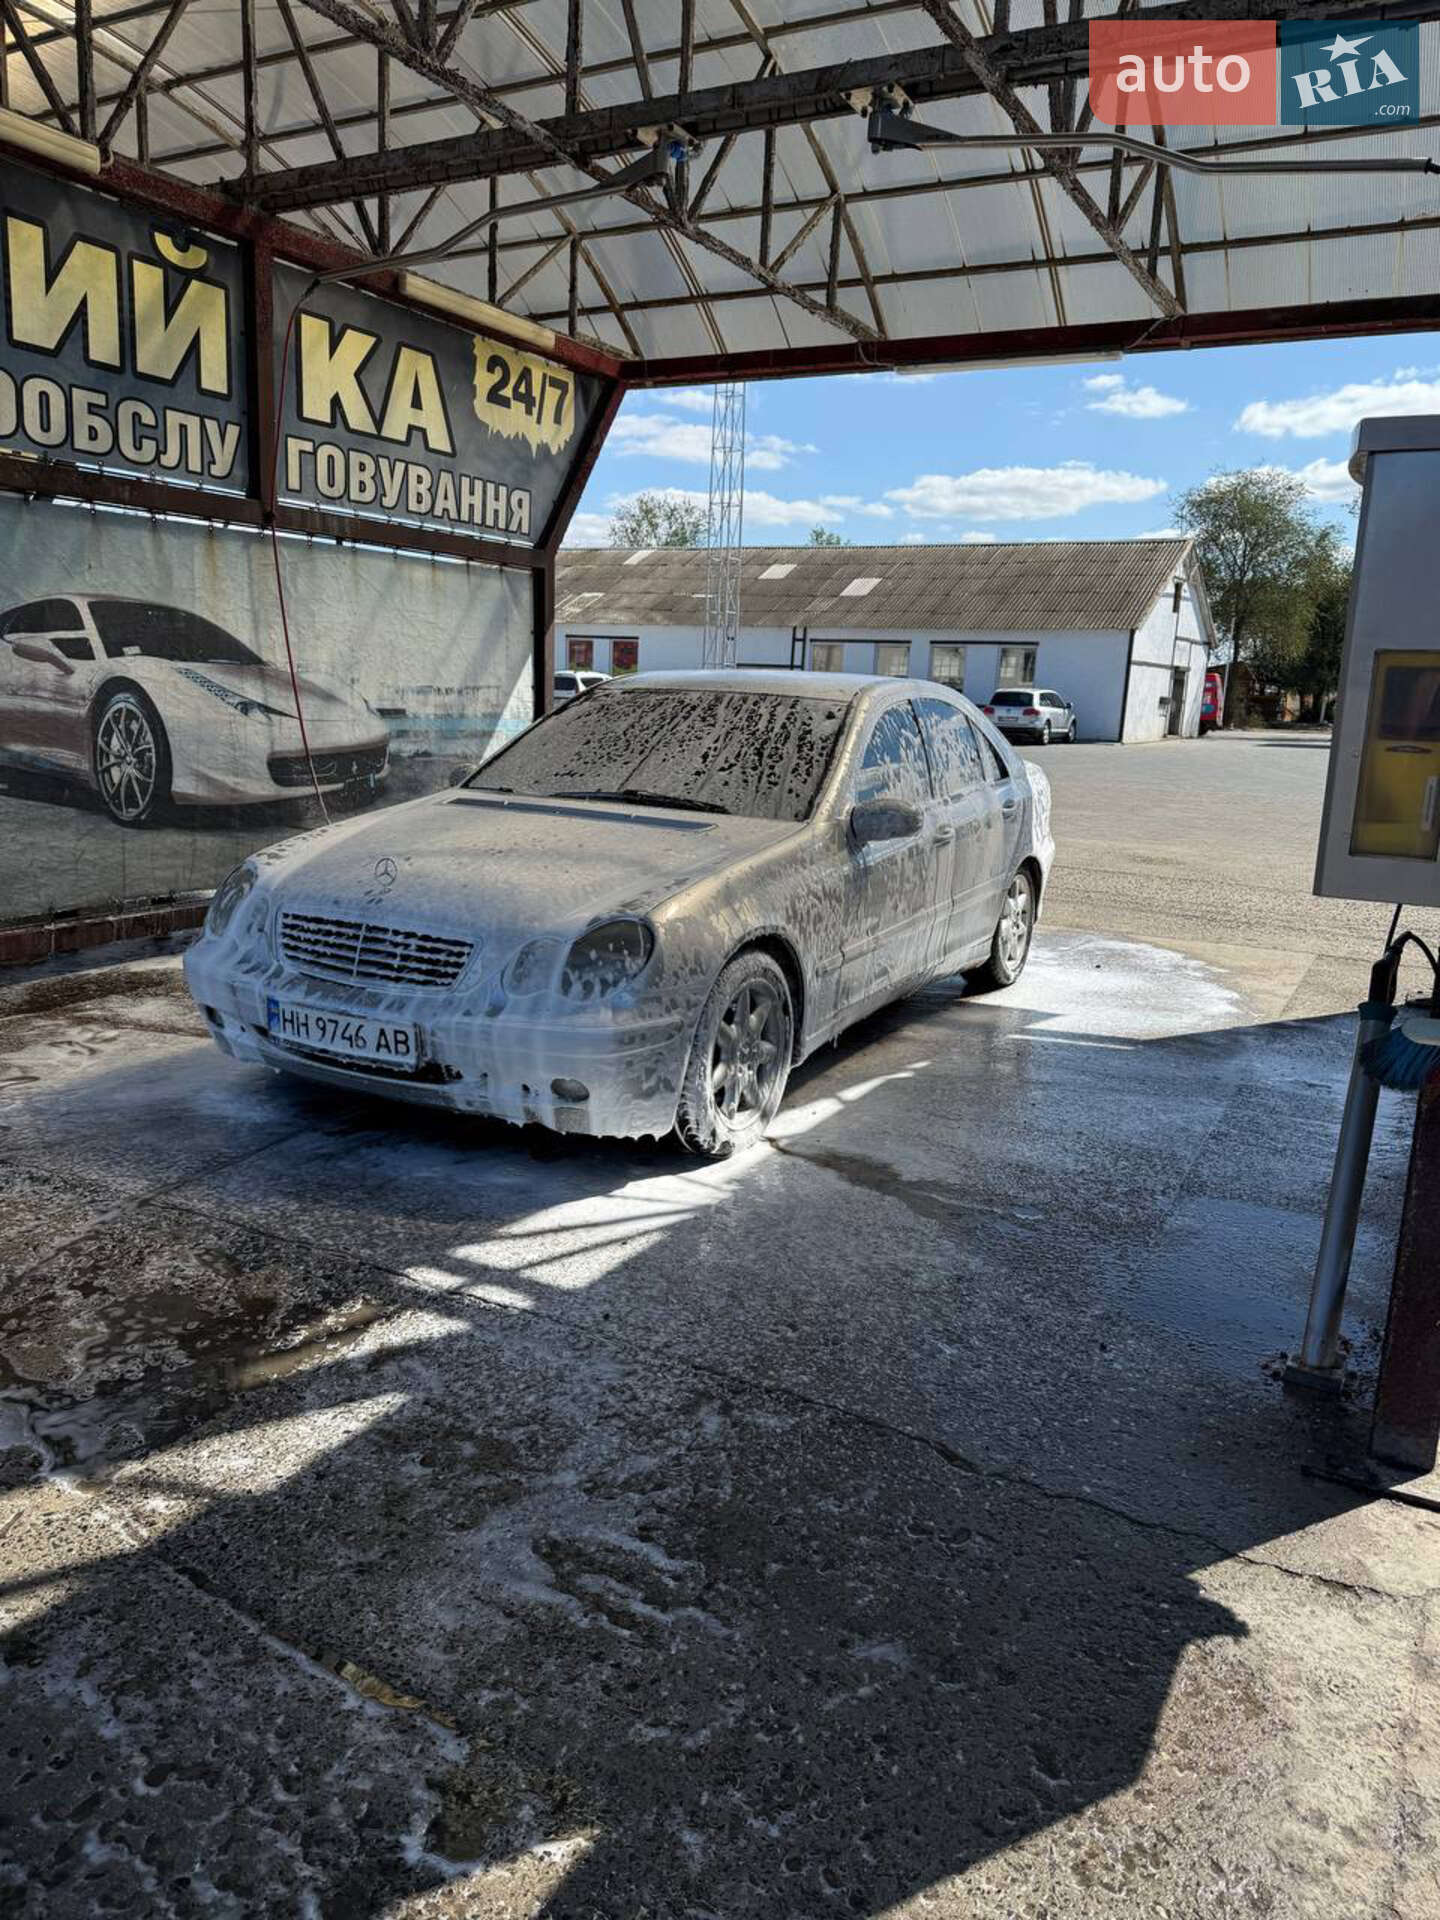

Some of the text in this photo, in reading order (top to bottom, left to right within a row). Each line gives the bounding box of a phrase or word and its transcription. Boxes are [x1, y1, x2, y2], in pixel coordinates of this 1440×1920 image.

[5, 214, 231, 397] ИЙ
[299, 312, 455, 455] КА
[485, 354, 570, 426] 24/7
[286, 437, 532, 535] ГОВУВАННЯ
[281, 1007, 310, 1038] HH
[315, 1016, 368, 1049] 9746
[375, 1027, 411, 1057] AB
